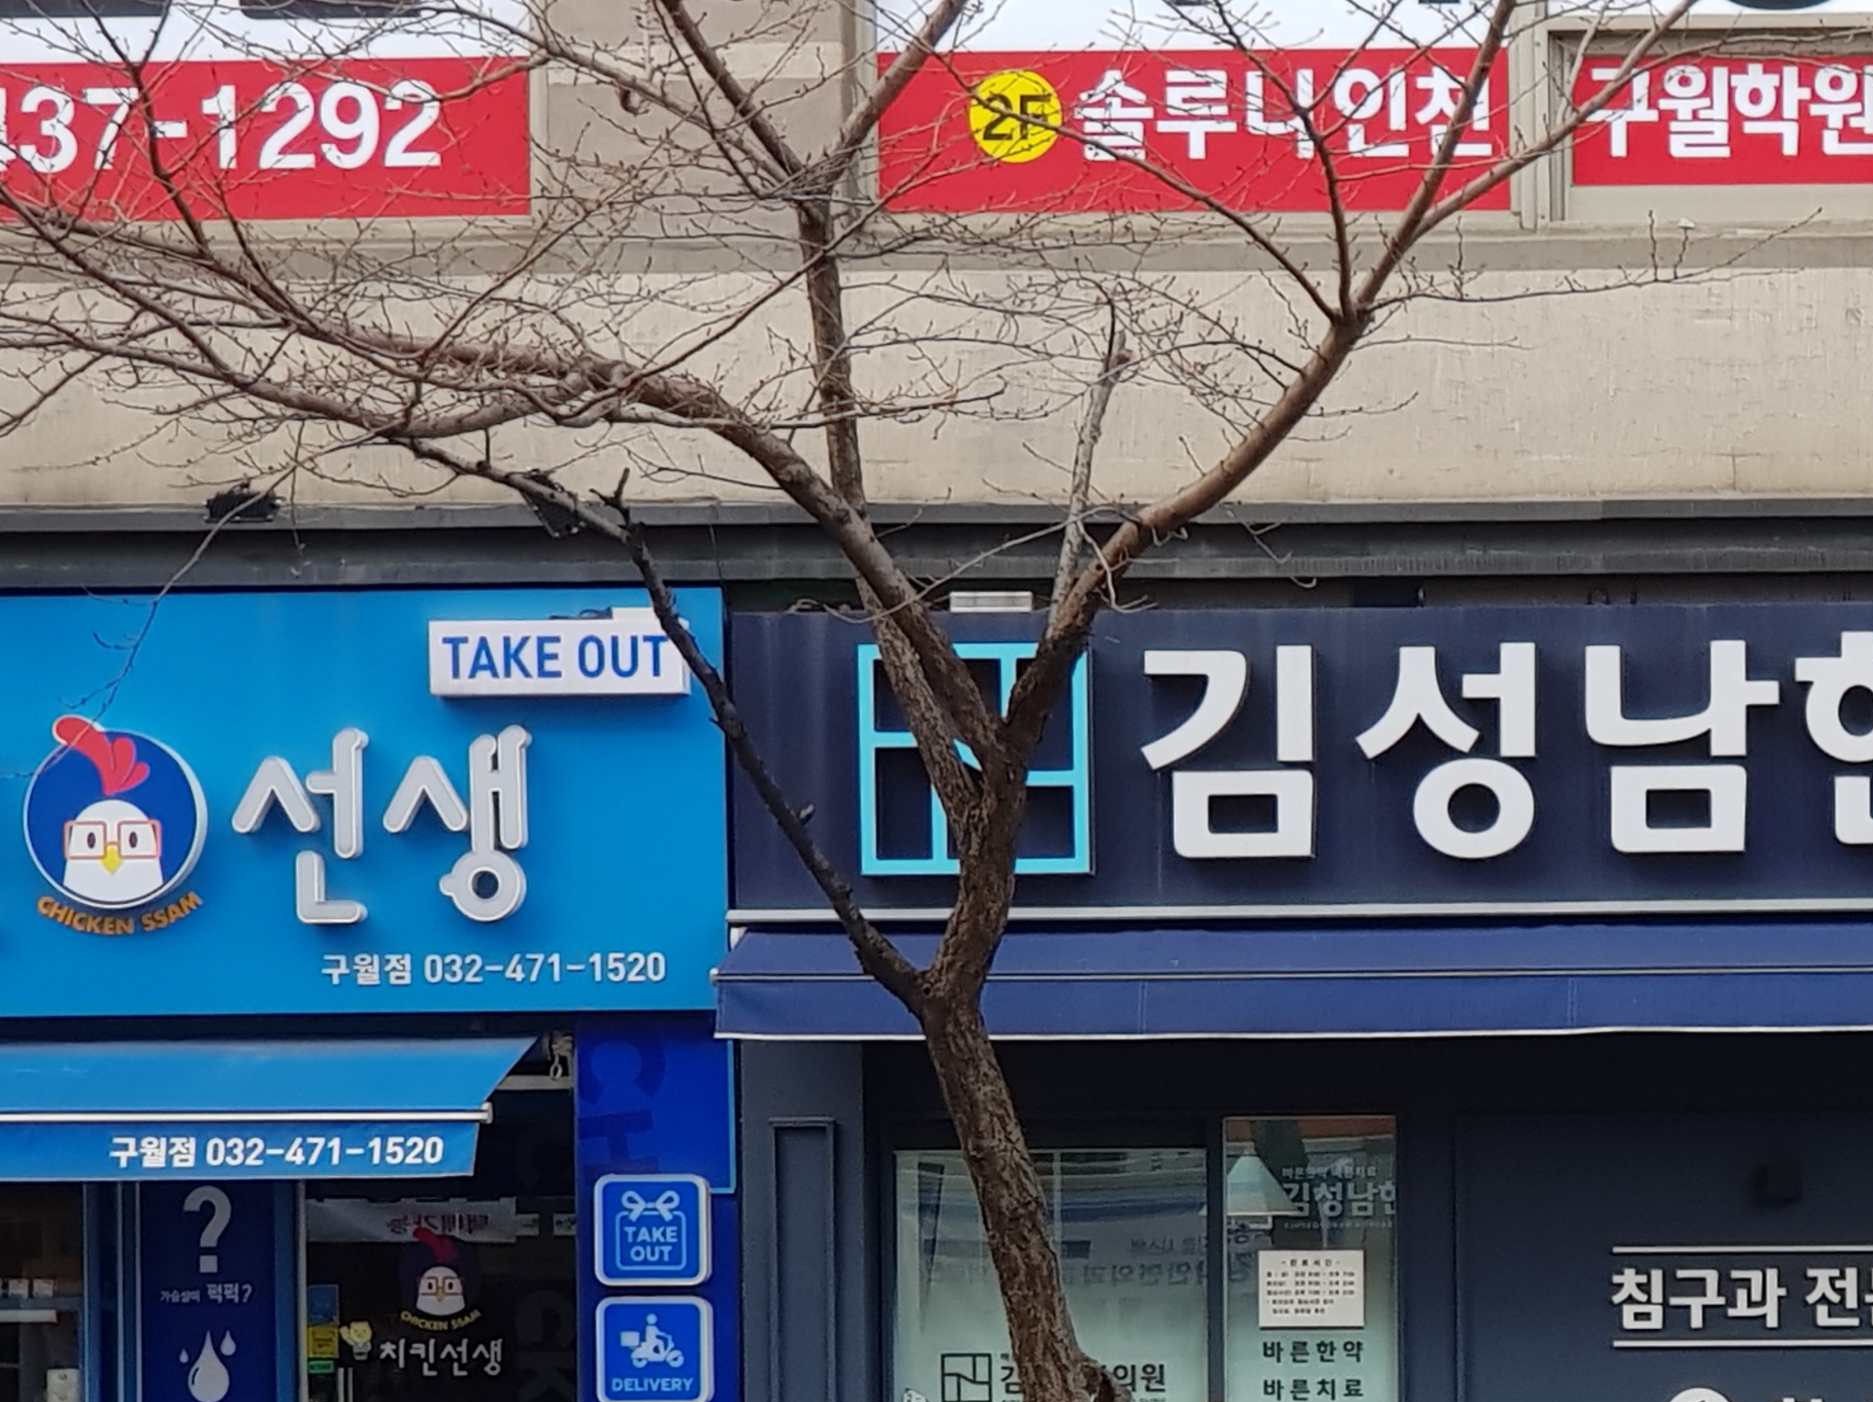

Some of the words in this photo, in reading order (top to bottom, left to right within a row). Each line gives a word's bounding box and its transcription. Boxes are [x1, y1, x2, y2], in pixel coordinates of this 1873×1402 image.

[0, 82, 442, 174] 37-1292
[979, 90, 1056, 143] 2F
[441, 635, 562, 681] TAKE
[577, 634, 670, 679] OUT
[231, 725, 533, 923] 선생
[36, 896, 135, 935] CHICKEN
[140, 890, 204, 934] SSAM
[321, 953, 413, 987] 구월점
[424, 952, 667, 985] 032-471-1520
[109, 1136, 197, 1169] 구월점
[205, 1135, 444, 1167] 032-471-1520
[623, 1226, 678, 1243] TAKE
[629, 1245, 673, 1262] OUT
[1611, 1267, 1787, 1330] 침구과
[400, 1309, 449, 1331] CHICKEN
[379, 1338, 503, 1377] 치킨선생
[1262, 1340, 1365, 1364] 바른한약
[611, 1377, 694, 1392] DELIVERY
[1262, 1377, 1365, 1402] 바른치료
